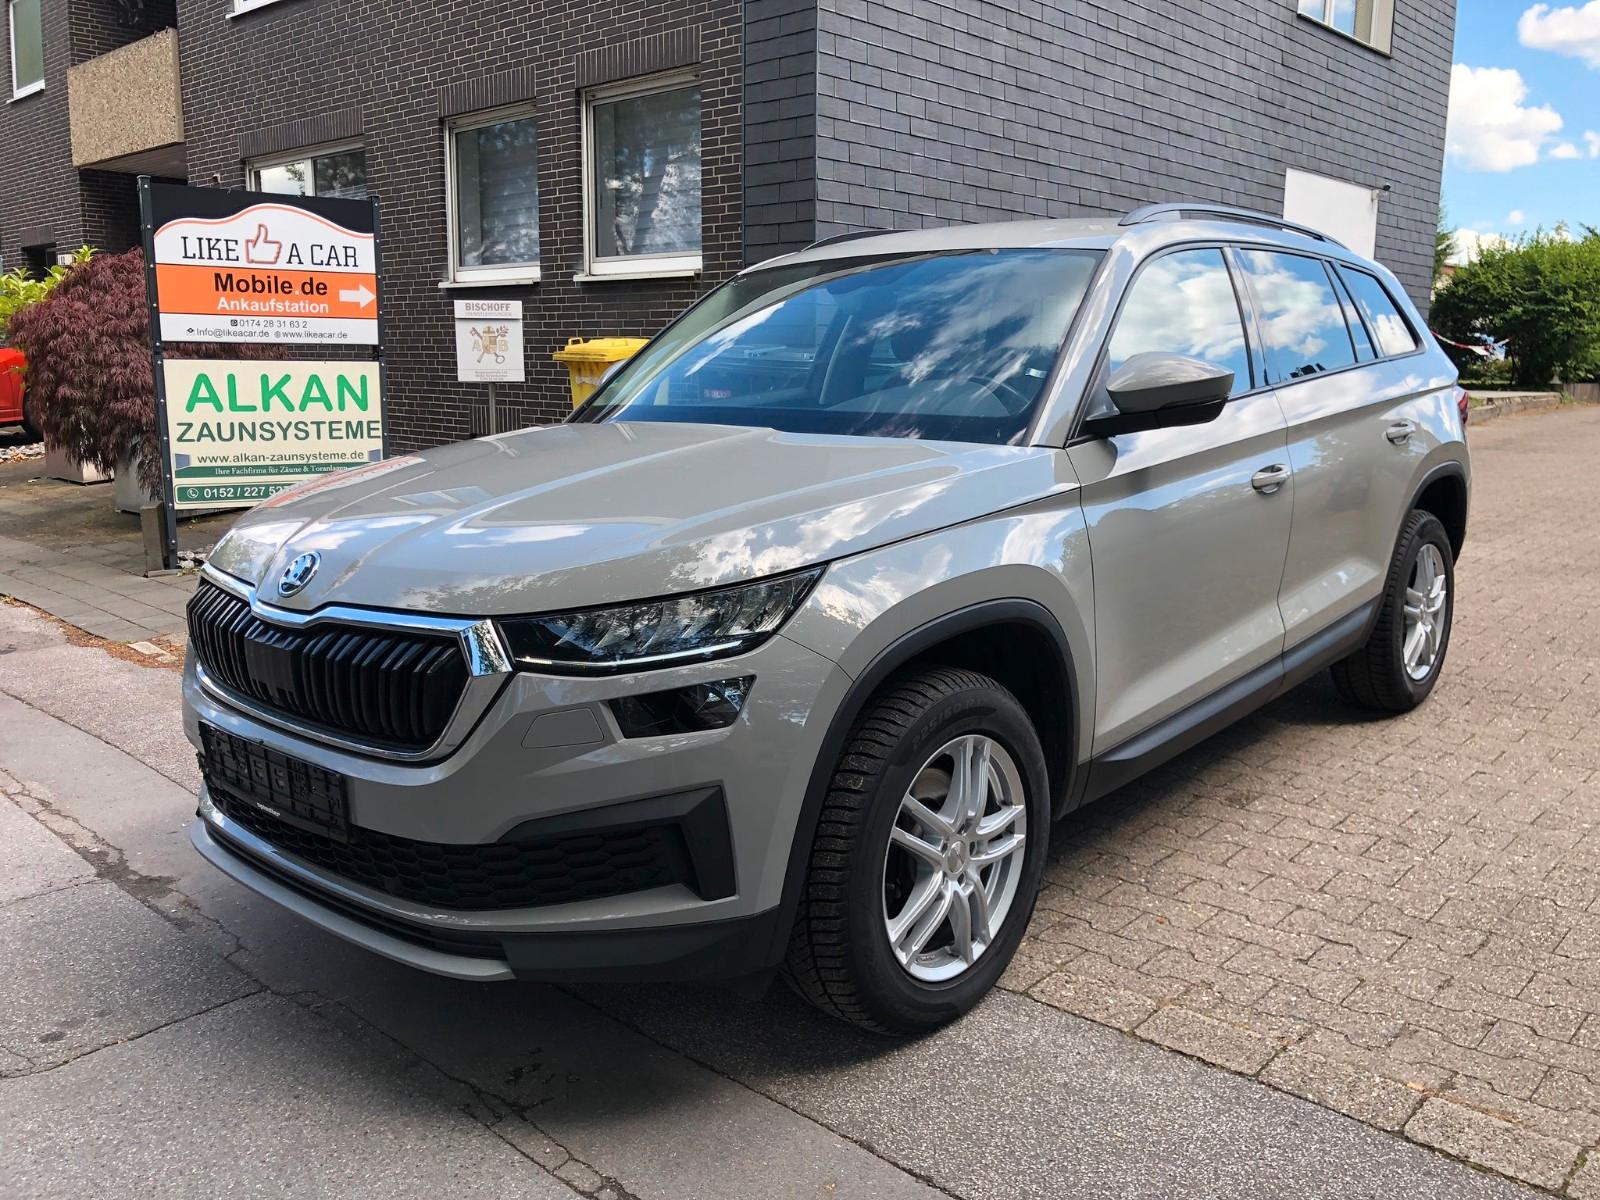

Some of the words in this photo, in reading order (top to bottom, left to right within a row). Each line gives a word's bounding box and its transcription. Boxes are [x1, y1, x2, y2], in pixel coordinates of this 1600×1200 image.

[181, 236, 239, 262] LIKE
[286, 243, 304, 265] A
[310, 244, 359, 268] CAR
[213, 272, 328, 296] Mobile.de
[217, 297, 329, 314] Ankaufstation
[465, 302, 511, 311] BISCHOFF
[239, 319, 261, 328] 0174
[263, 320, 274, 328] 28
[276, 320, 286, 328] 31
[289, 320, 300, 329] 63
[302, 321, 308, 329] 2
[196, 327, 270, 338] Info@likeacar.de
[282, 330, 348, 339] www.likeacar.de
[185, 373, 369, 413] ALKAN
[176, 420, 382, 443] ZAUNSYSTEME
[197, 450, 364, 463] www.alkan-zaunsysteme.de
[215, 467, 230, 475] Ihre
[231, 466, 267, 475] Fachfirma
[280, 465, 301, 473] Zäune
[203, 487, 234, 498] 0152
[244, 487, 265, 497] 227
